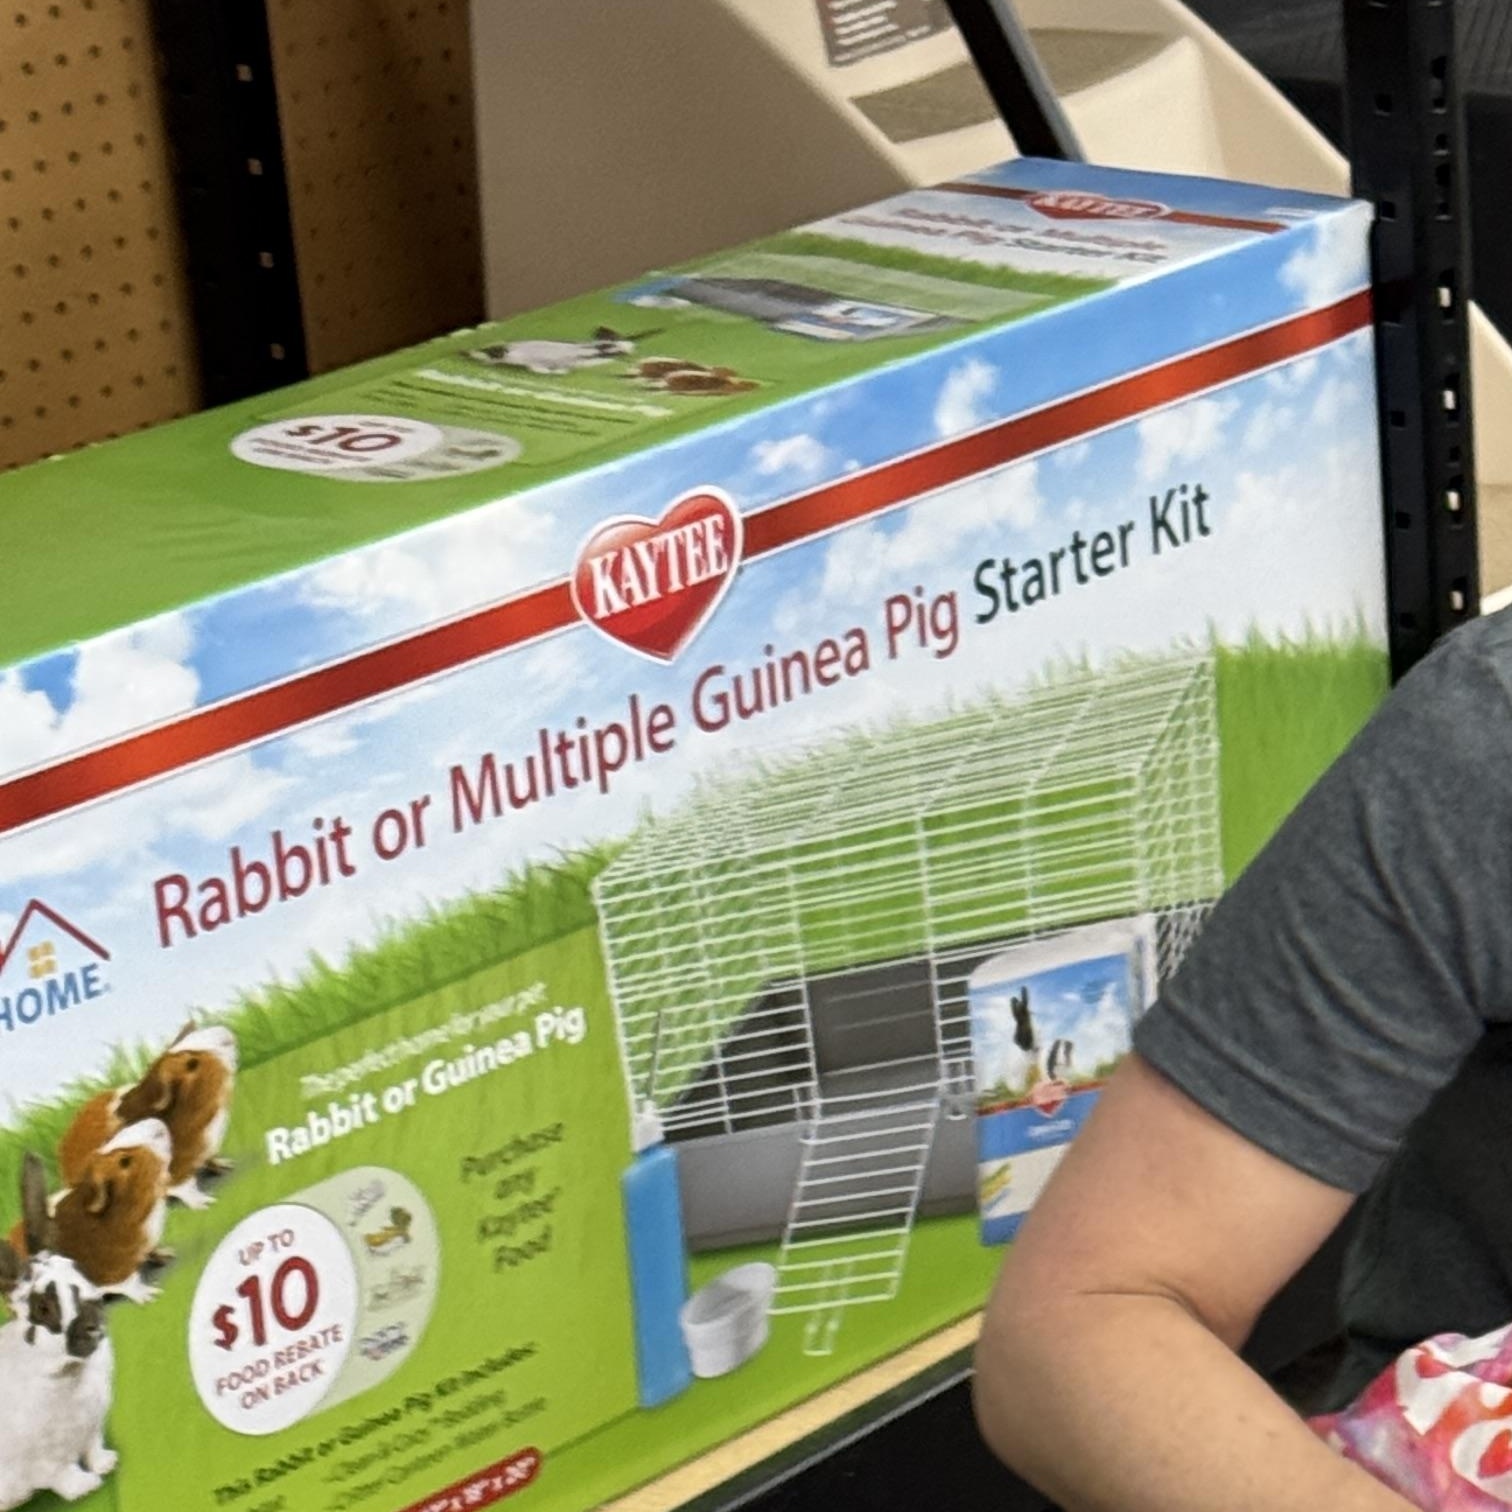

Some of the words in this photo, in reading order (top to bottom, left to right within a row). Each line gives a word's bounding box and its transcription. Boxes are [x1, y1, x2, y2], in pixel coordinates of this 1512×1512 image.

[588, 513, 729, 620] KAYTEE
[153, 816, 356, 948] Rabbit
[371, 795, 432, 861] or
[448, 694, 678, 834] Multiple
[691, 624, 871, 734] Guinea
[884, 585, 961, 659] Pig
[972, 516, 1136, 625] Starter
[1147, 482, 1212, 556] Kit
[265, 1091, 379, 1166] Rabbit
[381, 1077, 419, 1114] or
[421, 1030, 534, 1096] Guinea
[535, 1005, 589, 1049] Pig
[238, 1240, 265, 1267] UP
[267, 1228, 296, 1254] TO
[211, 1255, 320, 1352] $10
[215, 1357, 270, 1397] FOOD
[273, 1323, 345, 1370] REBATE
[240, 1384, 271, 1410] ON
[273, 1358, 326, 1397] BACK
